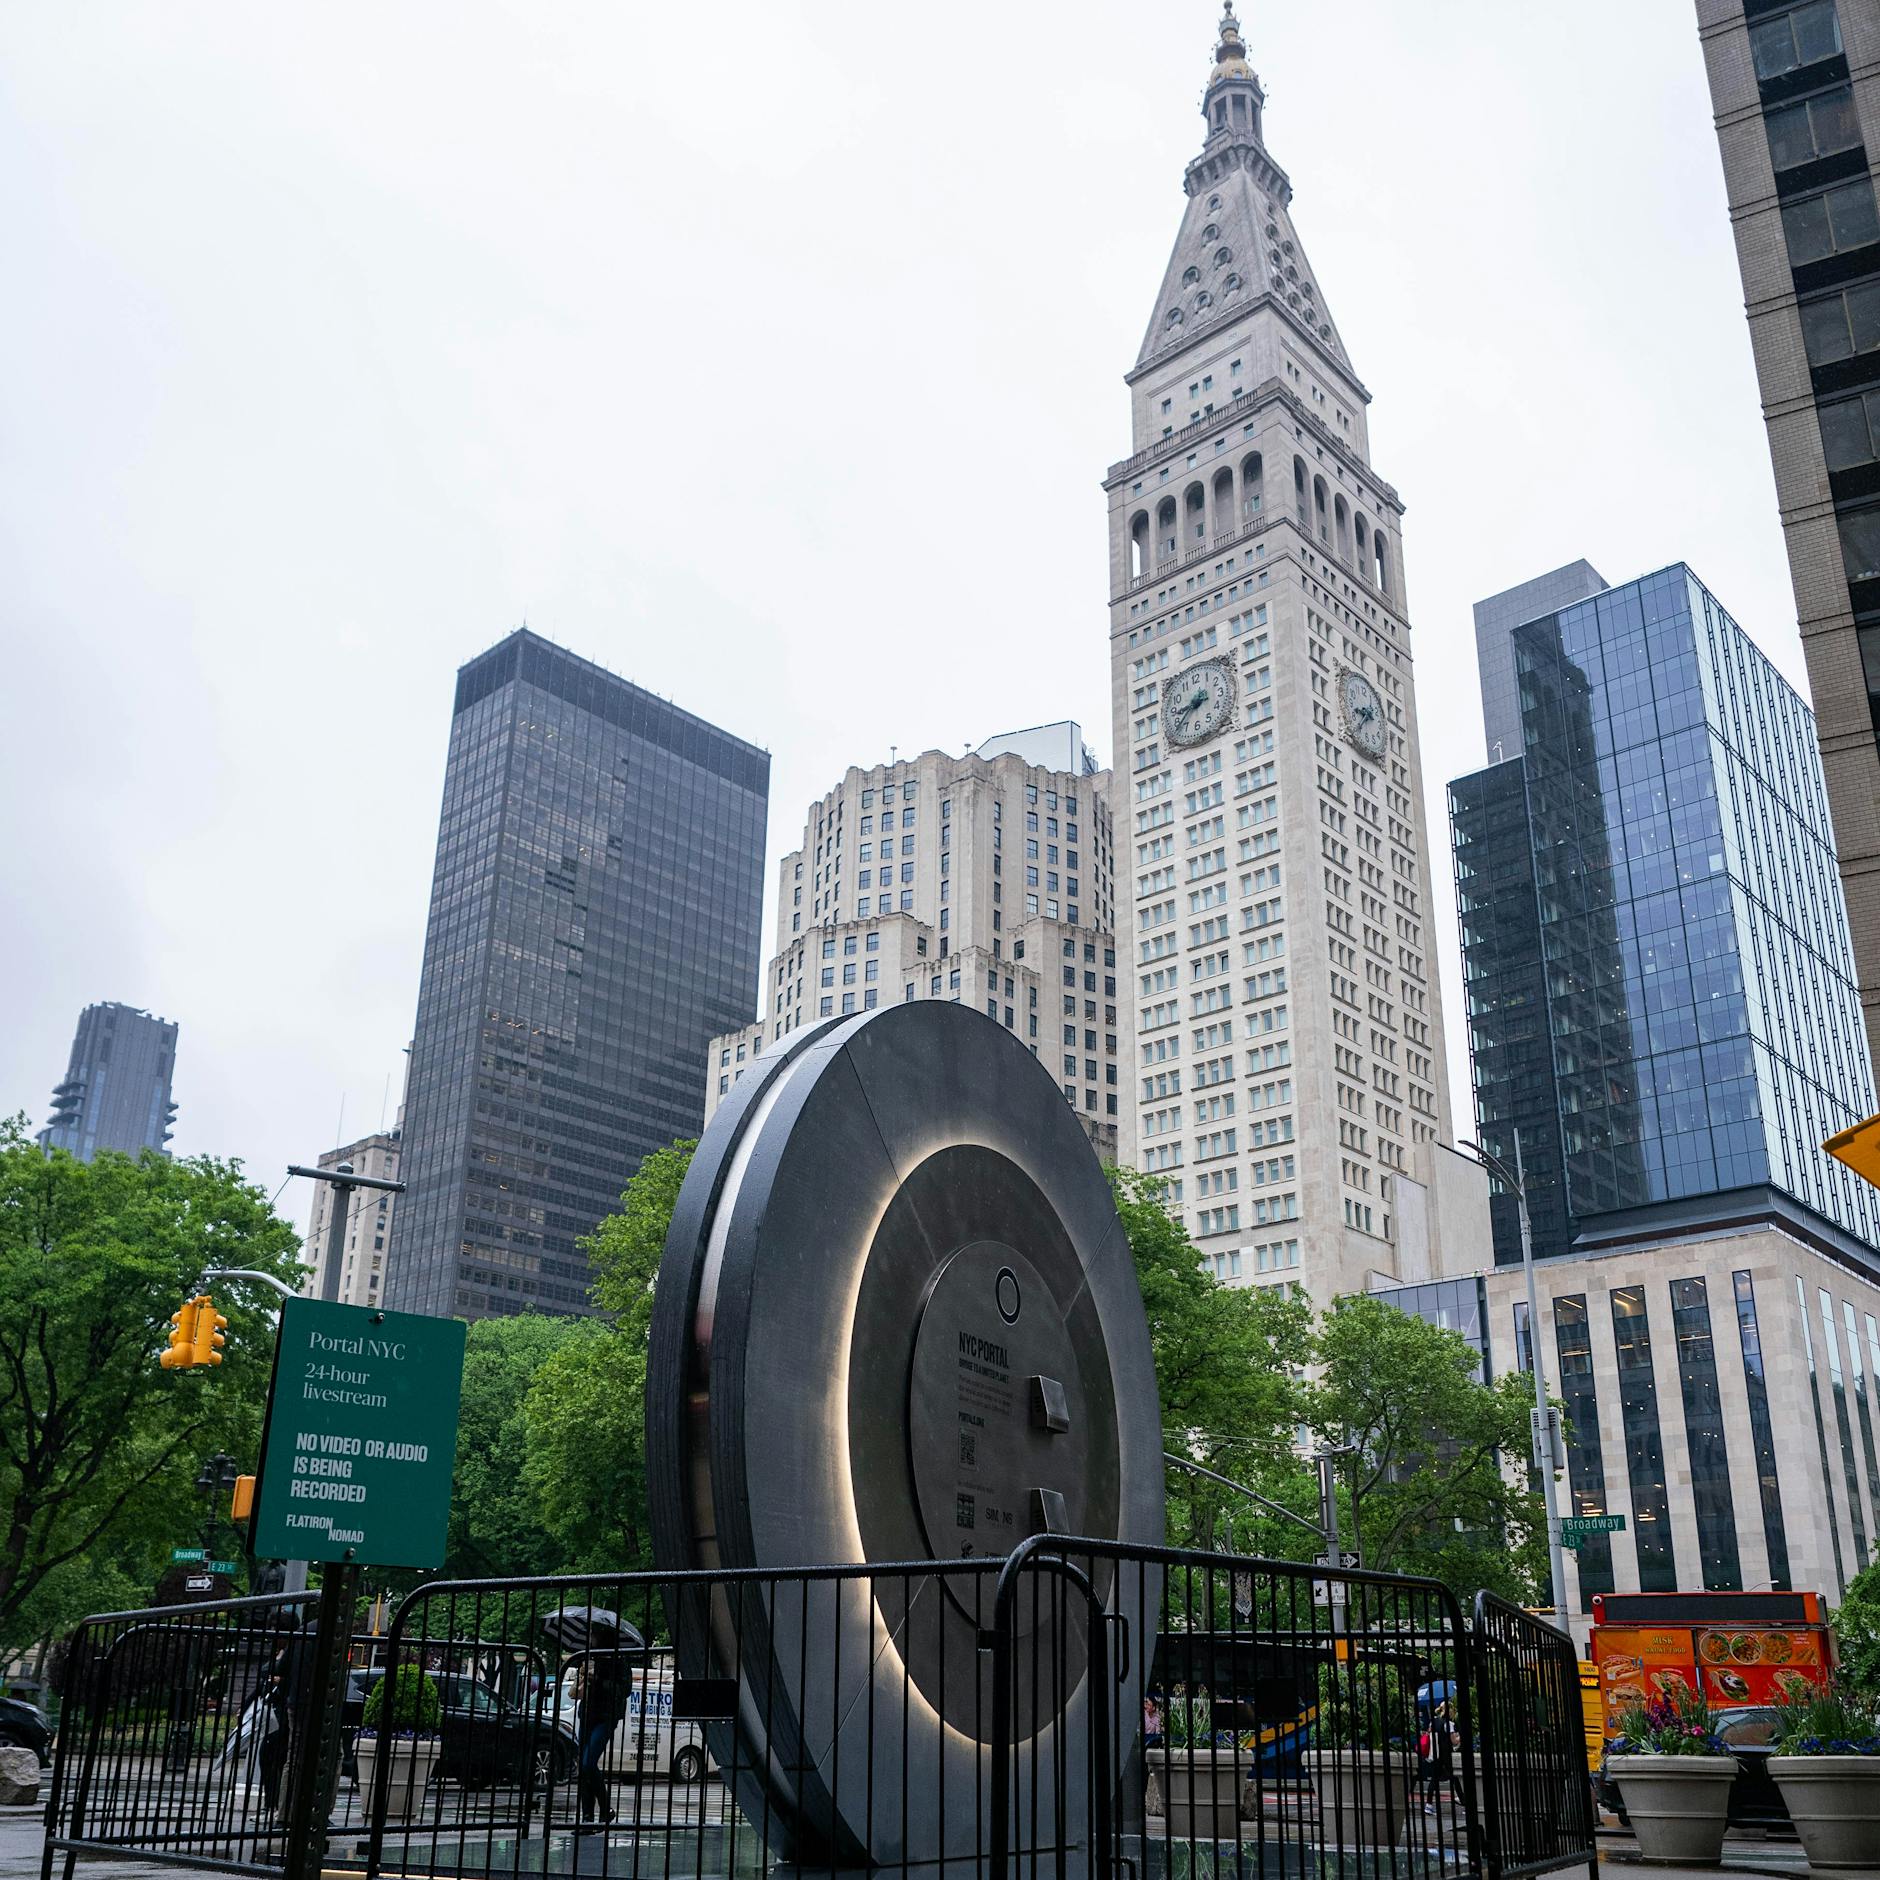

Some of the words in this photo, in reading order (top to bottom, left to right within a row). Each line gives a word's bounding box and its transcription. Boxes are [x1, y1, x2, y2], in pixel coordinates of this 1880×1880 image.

[1191, 673, 1200, 685] 12
[1213, 676, 1219, 687] 2
[1182, 681, 1189, 692] 11
[1217, 687, 1224, 697] 3
[1173, 694, 1182, 705] 10
[1213, 700, 1220, 710] 4
[1205, 713, 1212, 723] 5
[1194, 721, 1201, 731] 6
[309, 1332, 364, 1356] Portal
[368, 1339, 406, 1361] NYC
[959, 1331, 976, 1357] NYC
[977, 1337, 1009, 1369] PORTAL
[304, 1362, 370, 1385] 24-hour
[303, 1382, 387, 1408] livestream
[296, 1432, 317, 1451] NO
[320, 1435, 361, 1456] VIDEO
[364, 1439, 384, 1458] OR
[385, 1441, 428, 1462] AUDIO
[293, 1456, 308, 1474] IS
[309, 1458, 352, 1478] BEING
[290, 1479, 366, 1503] RECORDED
[286, 1514, 333, 1530] FLATIRON
[985, 1507, 1013, 1525] SIMNS
[1567, 1518, 1619, 1531] Broadway
[328, 1529, 364, 1543] NOMAD
[1563, 1533, 1568, 1546] E
[1568, 1534, 1575, 1547] 23
[175, 1551, 202, 1560] Broadway
[211, 1562, 216, 1571] E
[217, 1563, 225, 1572] 23
[630, 1692, 672, 1705] MTRO
[630, 1704, 665, 1715] PLBIG
